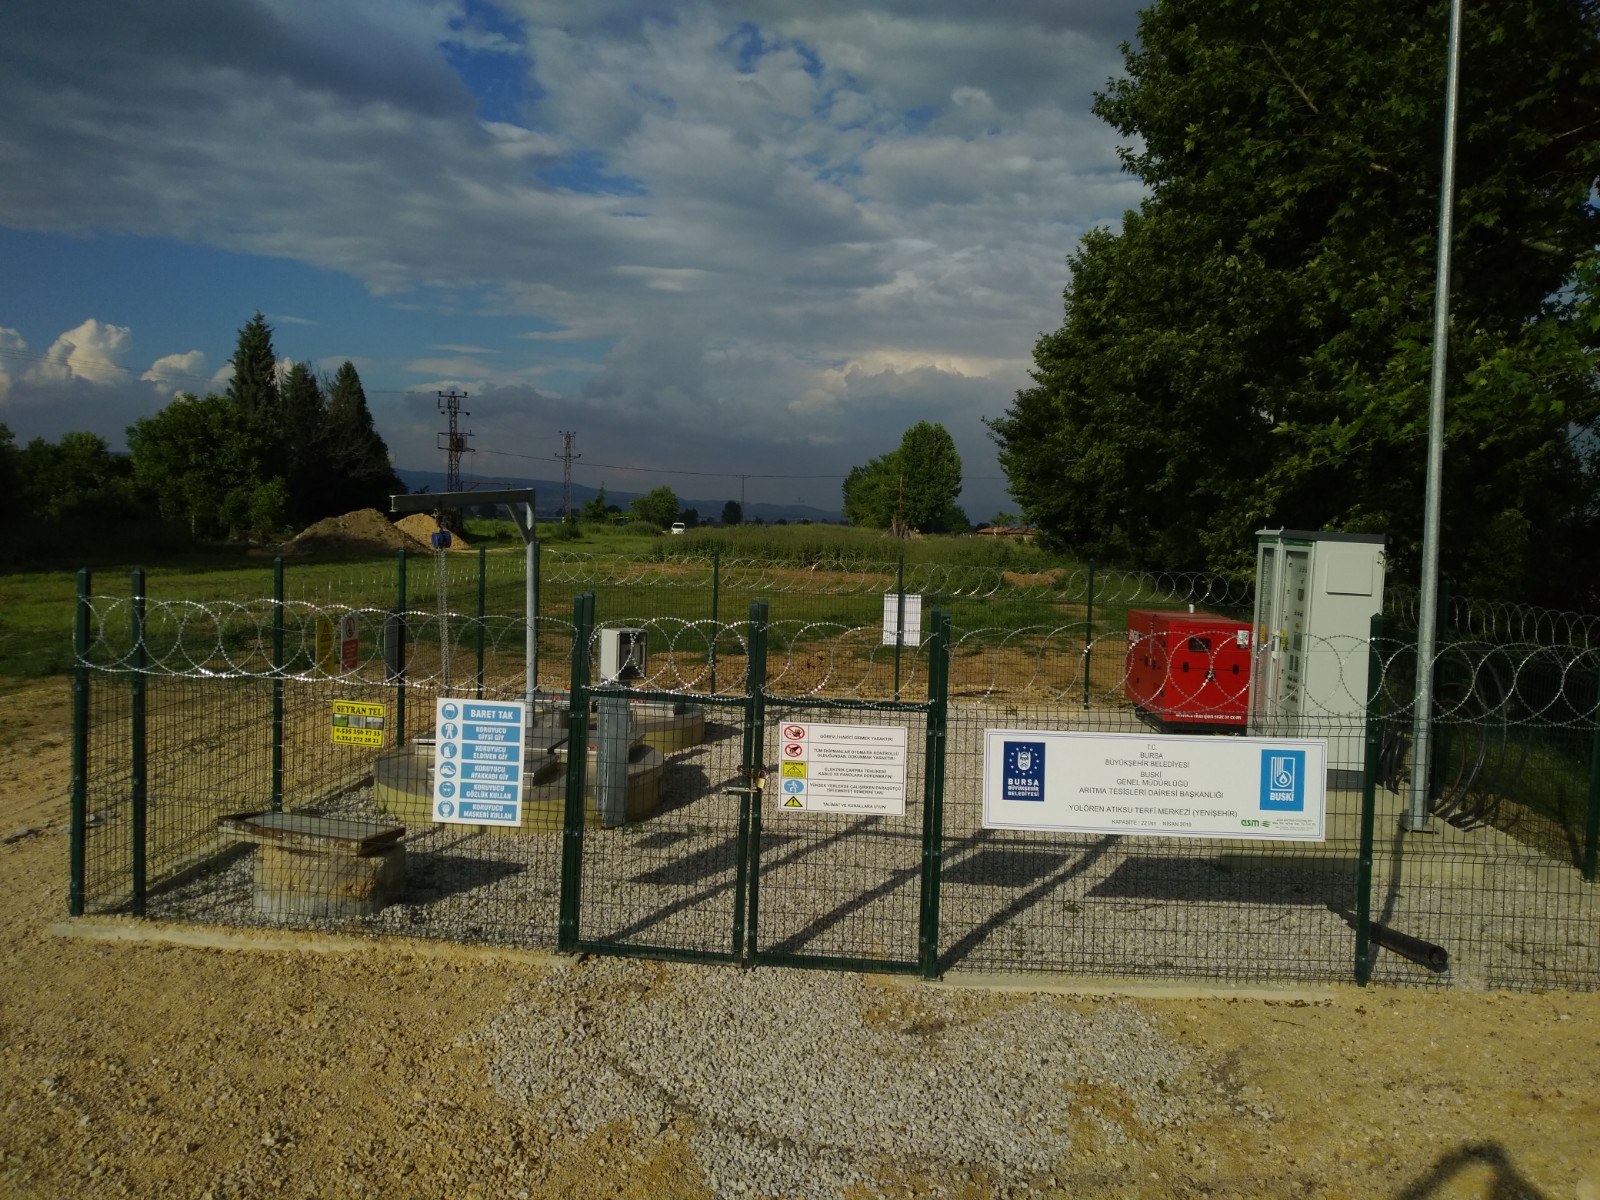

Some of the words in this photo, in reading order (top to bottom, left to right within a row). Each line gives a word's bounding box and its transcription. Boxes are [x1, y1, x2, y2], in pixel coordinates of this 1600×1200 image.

[336, 705, 366, 714] SEYRAN
[368, 708, 382, 716] TEL
[470, 710, 496, 718] BARET
[498, 710, 514, 719] TAK
[1105, 759, 1149, 767] BÜYÜKŞEHİR
[1008, 778, 1040, 786] BURSA
[1142, 779, 1189, 787] MÜDÜRLÜĞÜ
[1109, 788, 1146, 796] TESİSLERİ
[1148, 789, 1178, 797] DAİRESİ
[1180, 790, 1224, 799] BAŞKANLIĞI
[1270, 792, 1294, 802] BUSKİ
[1069, 804, 1104, 812] YOLÖREN
[1136, 806, 1157, 814] TERFİ
[1158, 808, 1191, 816] MERKEZİ
[1193, 808, 1238, 818] (YENİŞEHİR)
